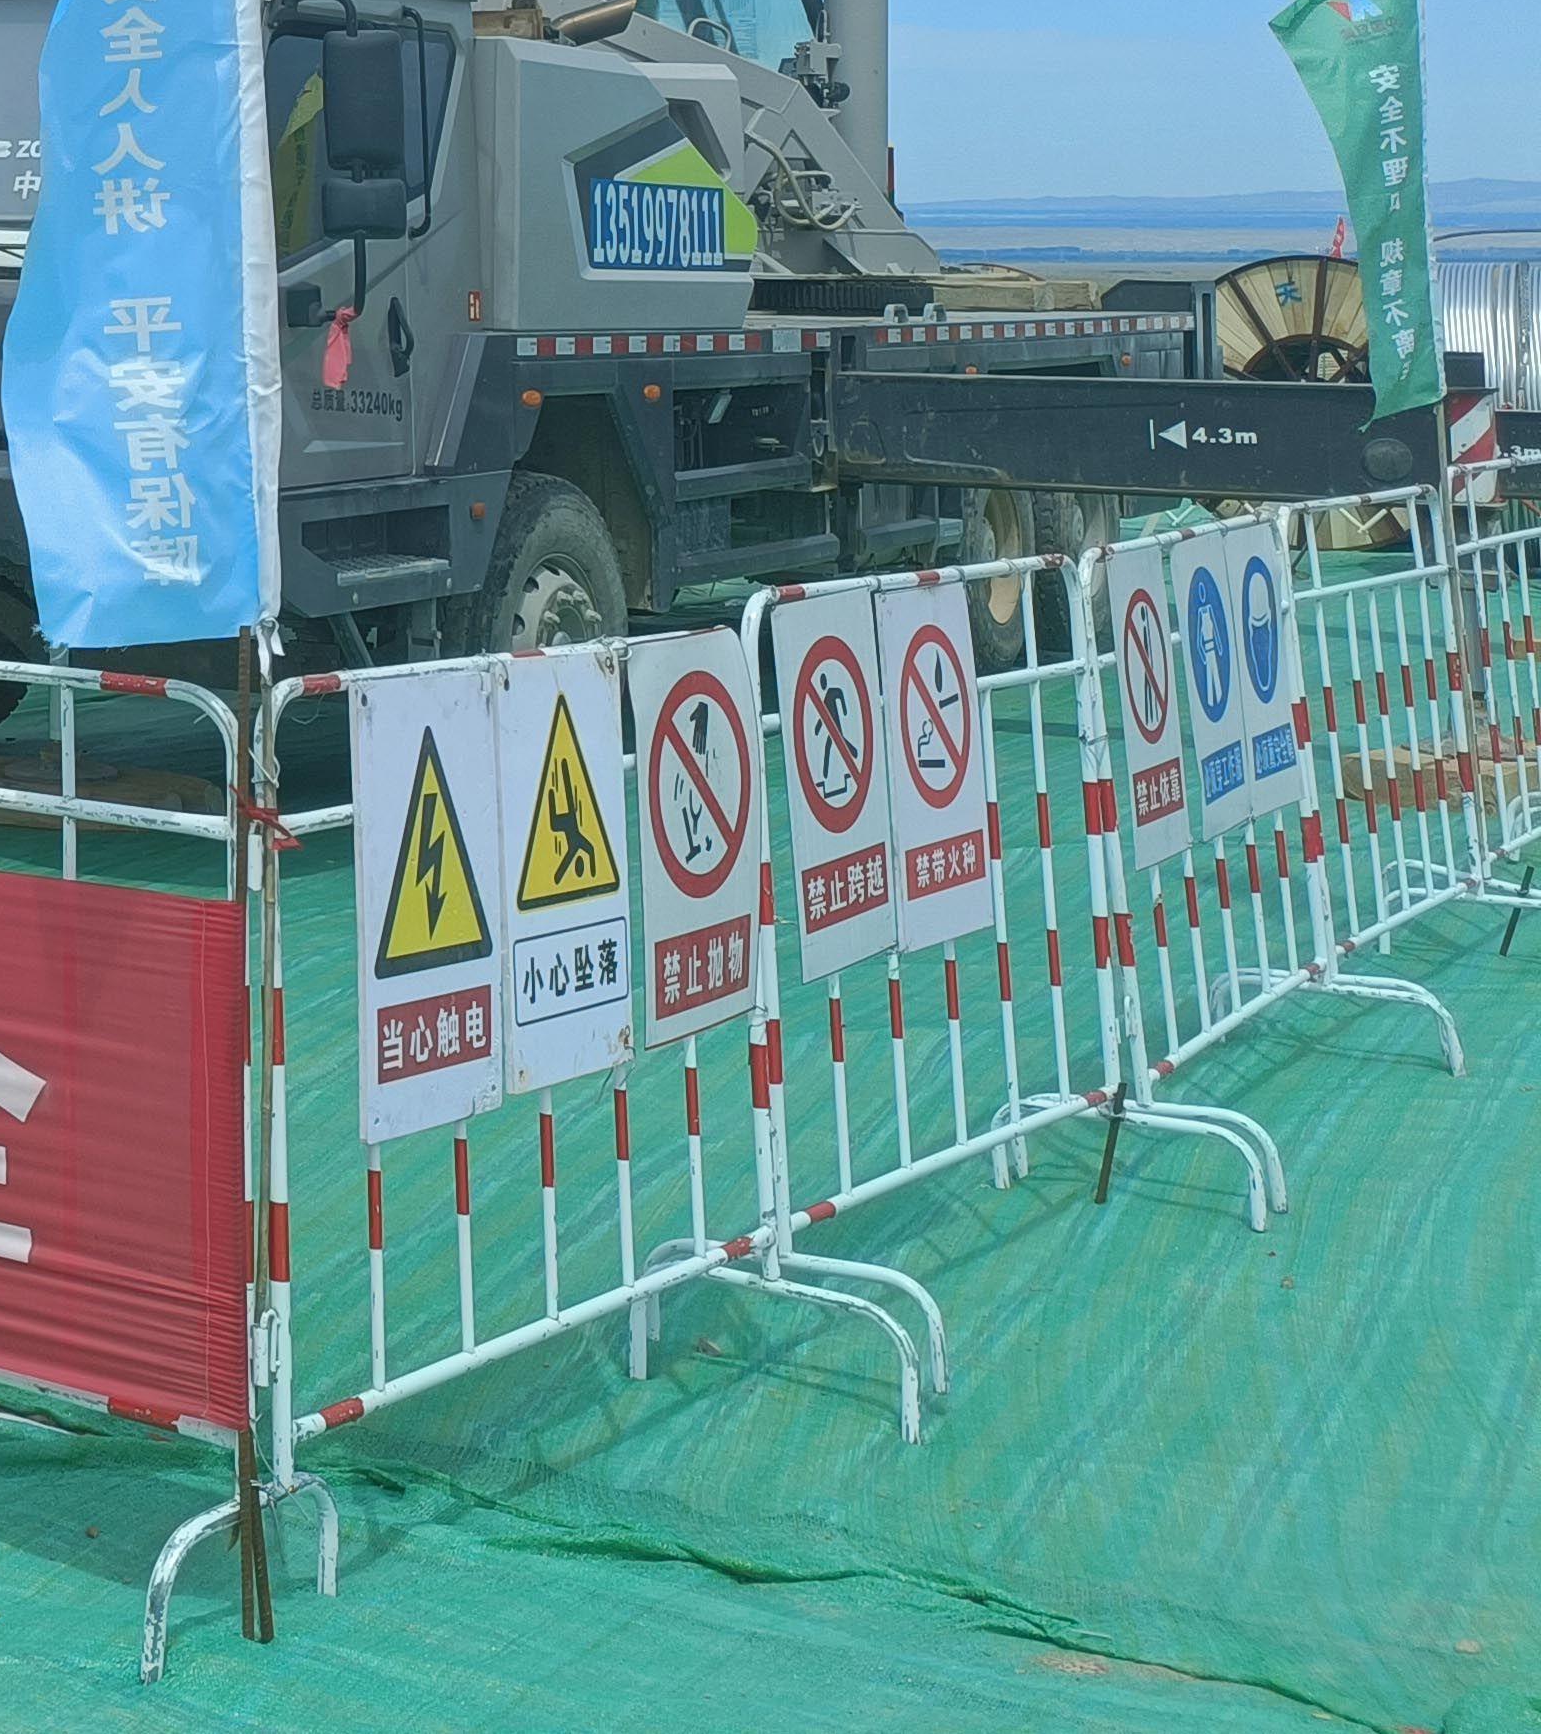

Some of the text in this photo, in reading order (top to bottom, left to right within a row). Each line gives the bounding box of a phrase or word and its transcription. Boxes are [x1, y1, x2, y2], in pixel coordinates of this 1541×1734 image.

[593, 183, 723, 267] 13519978111
[1192, 427, 1258, 444] 4.3m
[1136, 767, 1181, 817] 禁止依靠
[807, 854, 884, 920] 禁止跨越
[916, 839, 976, 888] 禁带火种
[523, 938, 618, 1004] 小心坠落
[664, 931, 744, 1004] 禁止抛物
[382, 1001, 487, 1070] 当心触电
